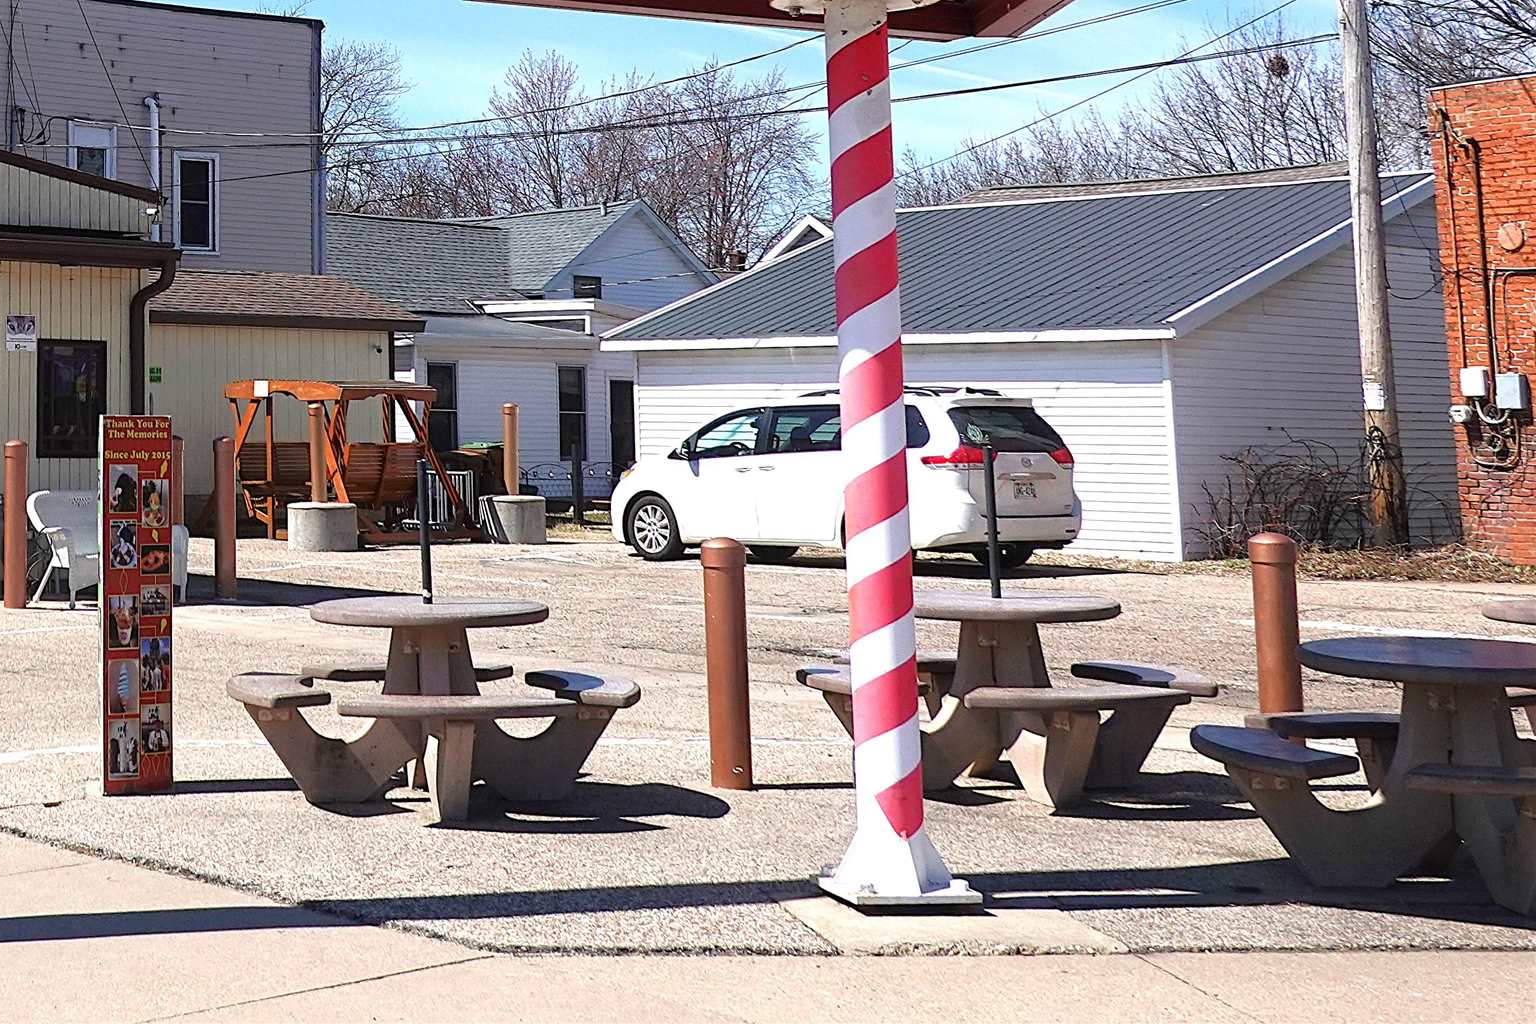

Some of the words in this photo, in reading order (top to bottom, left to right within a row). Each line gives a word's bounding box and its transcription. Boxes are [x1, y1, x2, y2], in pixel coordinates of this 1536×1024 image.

[106, 419, 135, 429] Thank
[137, 419, 153, 429] You
[155, 419, 169, 429] For
[108, 429, 125, 438] The
[126, 429, 168, 439] Memories
[104, 450, 128, 459] Since
[130, 450, 150, 461] July
[151, 451, 171, 460] 2015
